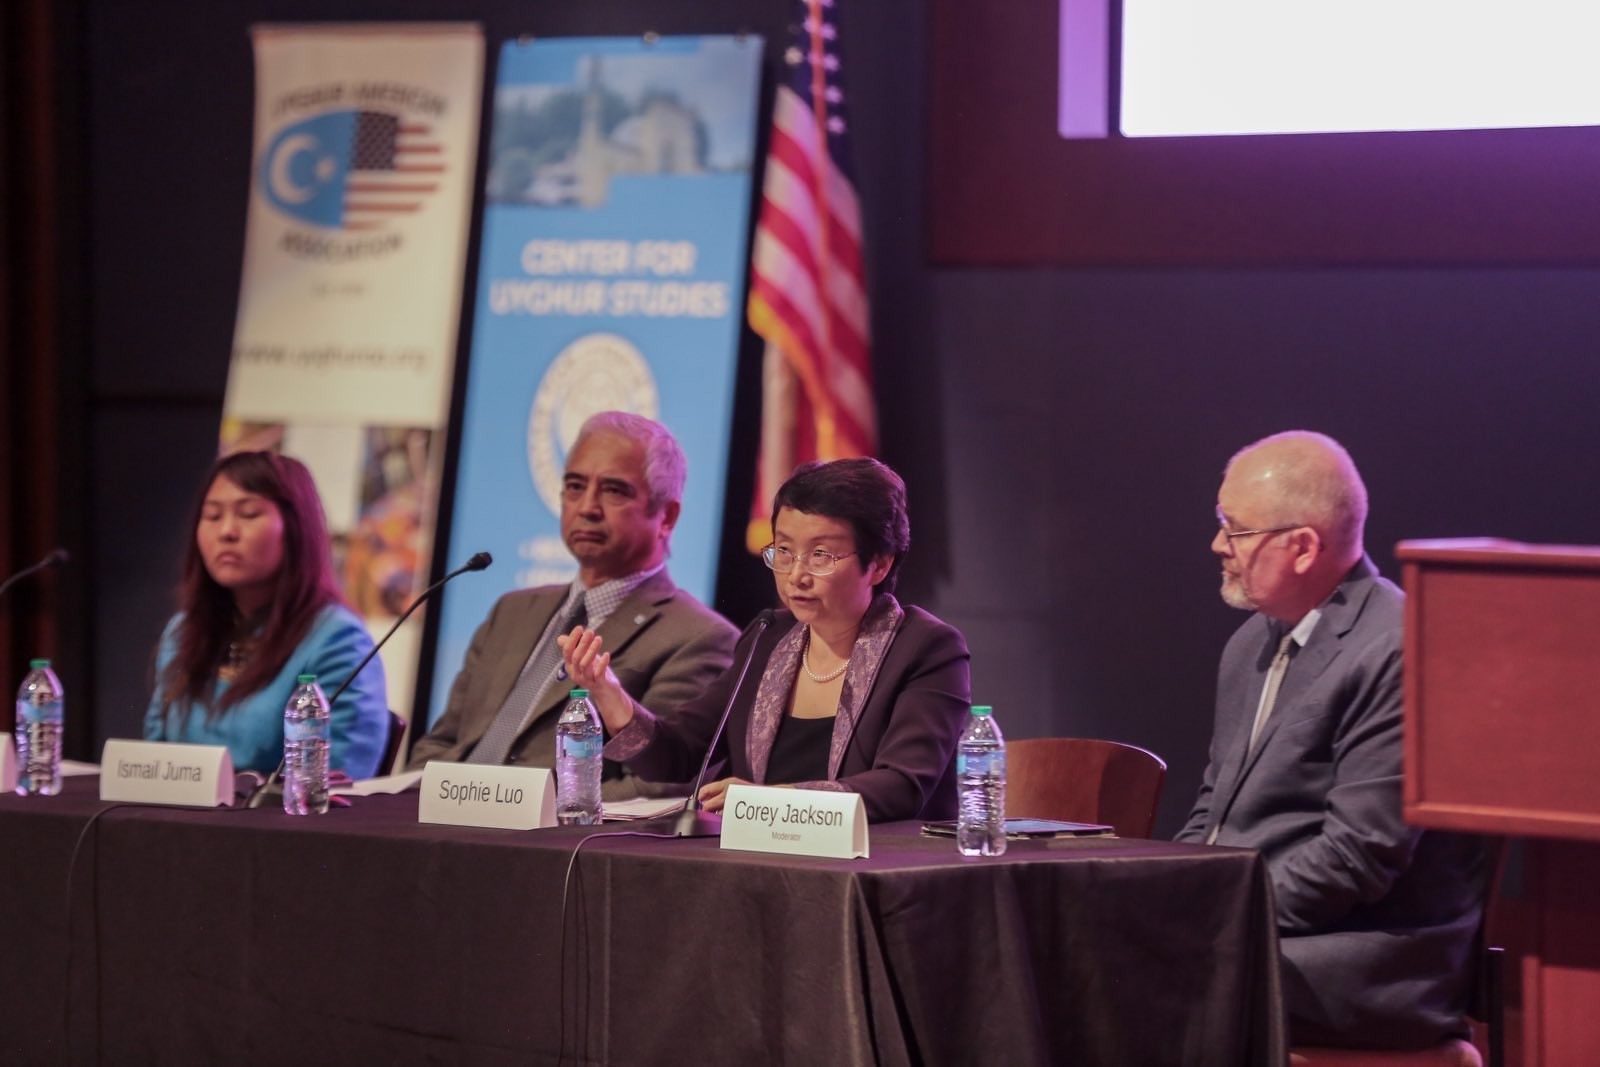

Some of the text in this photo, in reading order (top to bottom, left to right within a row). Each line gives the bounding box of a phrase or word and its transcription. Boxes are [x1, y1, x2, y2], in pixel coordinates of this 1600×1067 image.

[522, 239, 697, 276] CENTER FOR
[489, 280, 729, 318] UYGHUR STUDIES
[117, 760, 202, 782] Ismail Juma
[439, 780, 523, 806] Sophie Luo
[734, 800, 843, 827] Corey Jackson
[771, 831, 801, 841] Moderator
